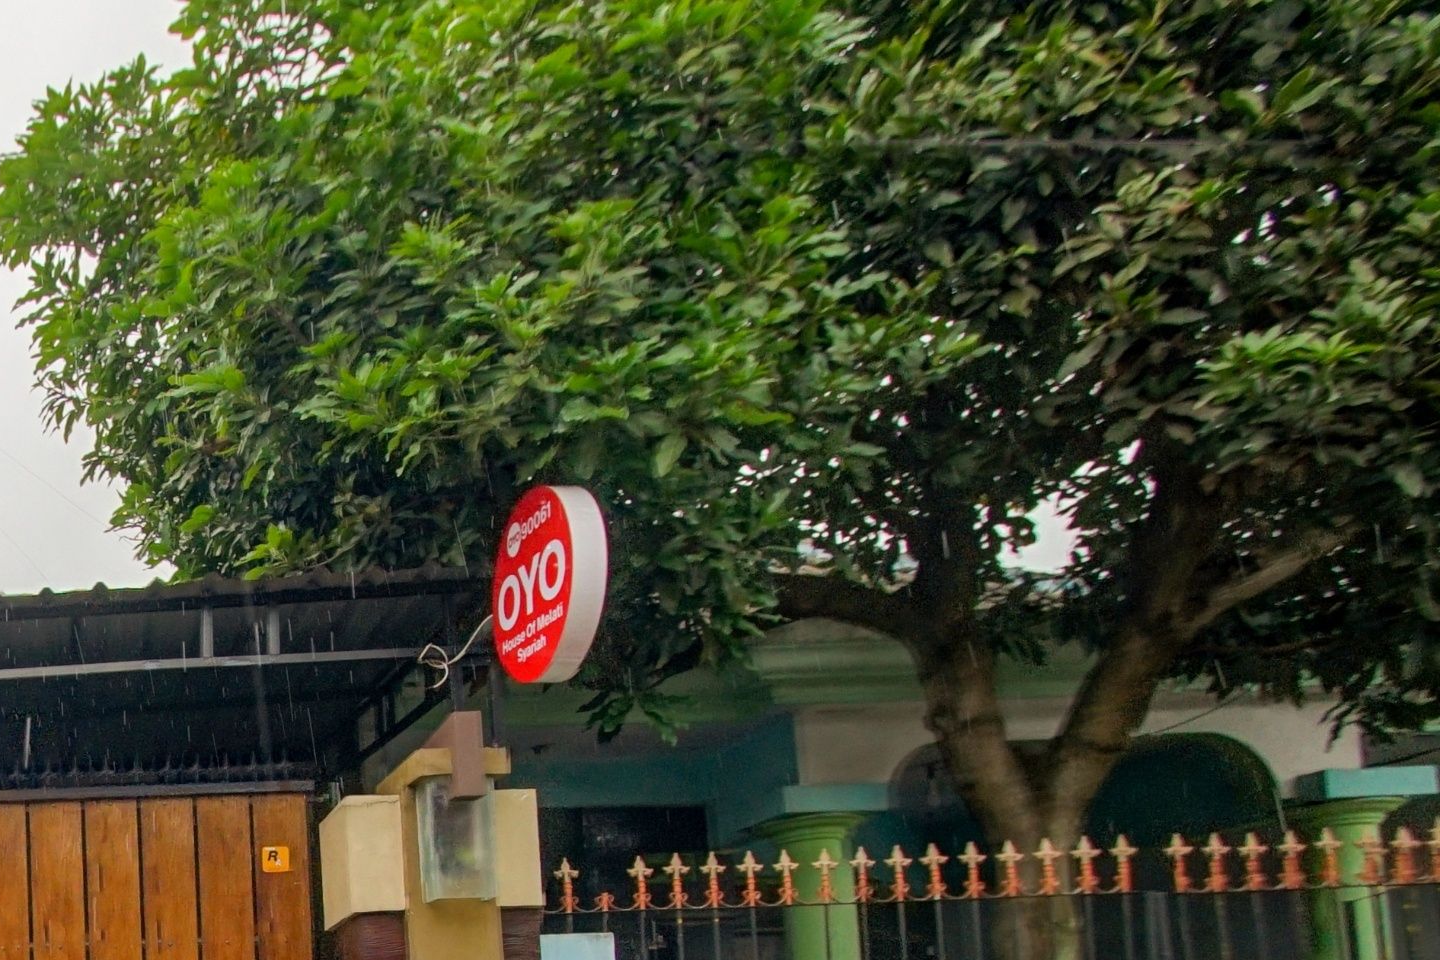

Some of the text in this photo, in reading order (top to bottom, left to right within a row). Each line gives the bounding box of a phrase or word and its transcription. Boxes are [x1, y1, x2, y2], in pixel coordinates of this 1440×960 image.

[498, 539, 566, 631] OYO
[502, 601, 563, 655] House Of Melati
[517, 634, 547, 663] Syariah
